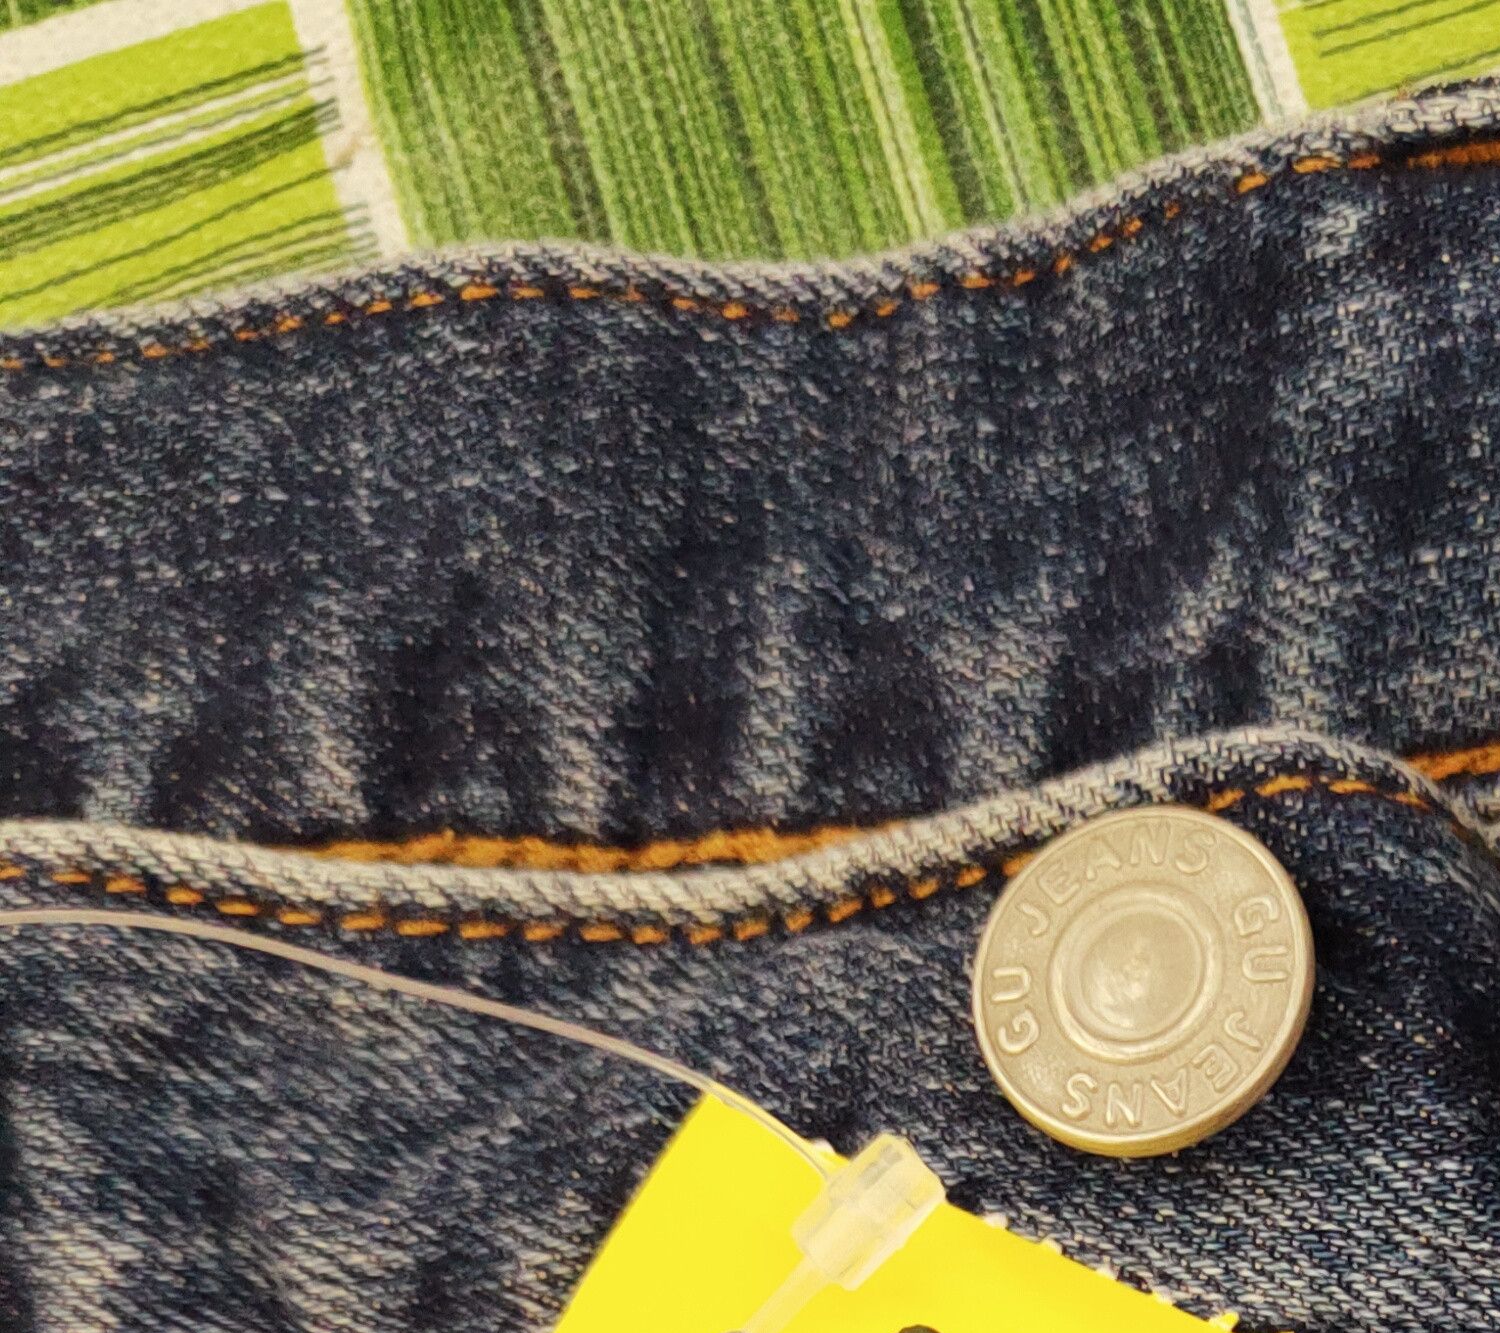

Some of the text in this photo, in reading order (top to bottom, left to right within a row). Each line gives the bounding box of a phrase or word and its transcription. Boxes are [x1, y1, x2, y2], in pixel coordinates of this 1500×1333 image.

[990, 818, 1217, 1054] GU JEANS
[1060, 896, 1289, 1128] GU JEANS
